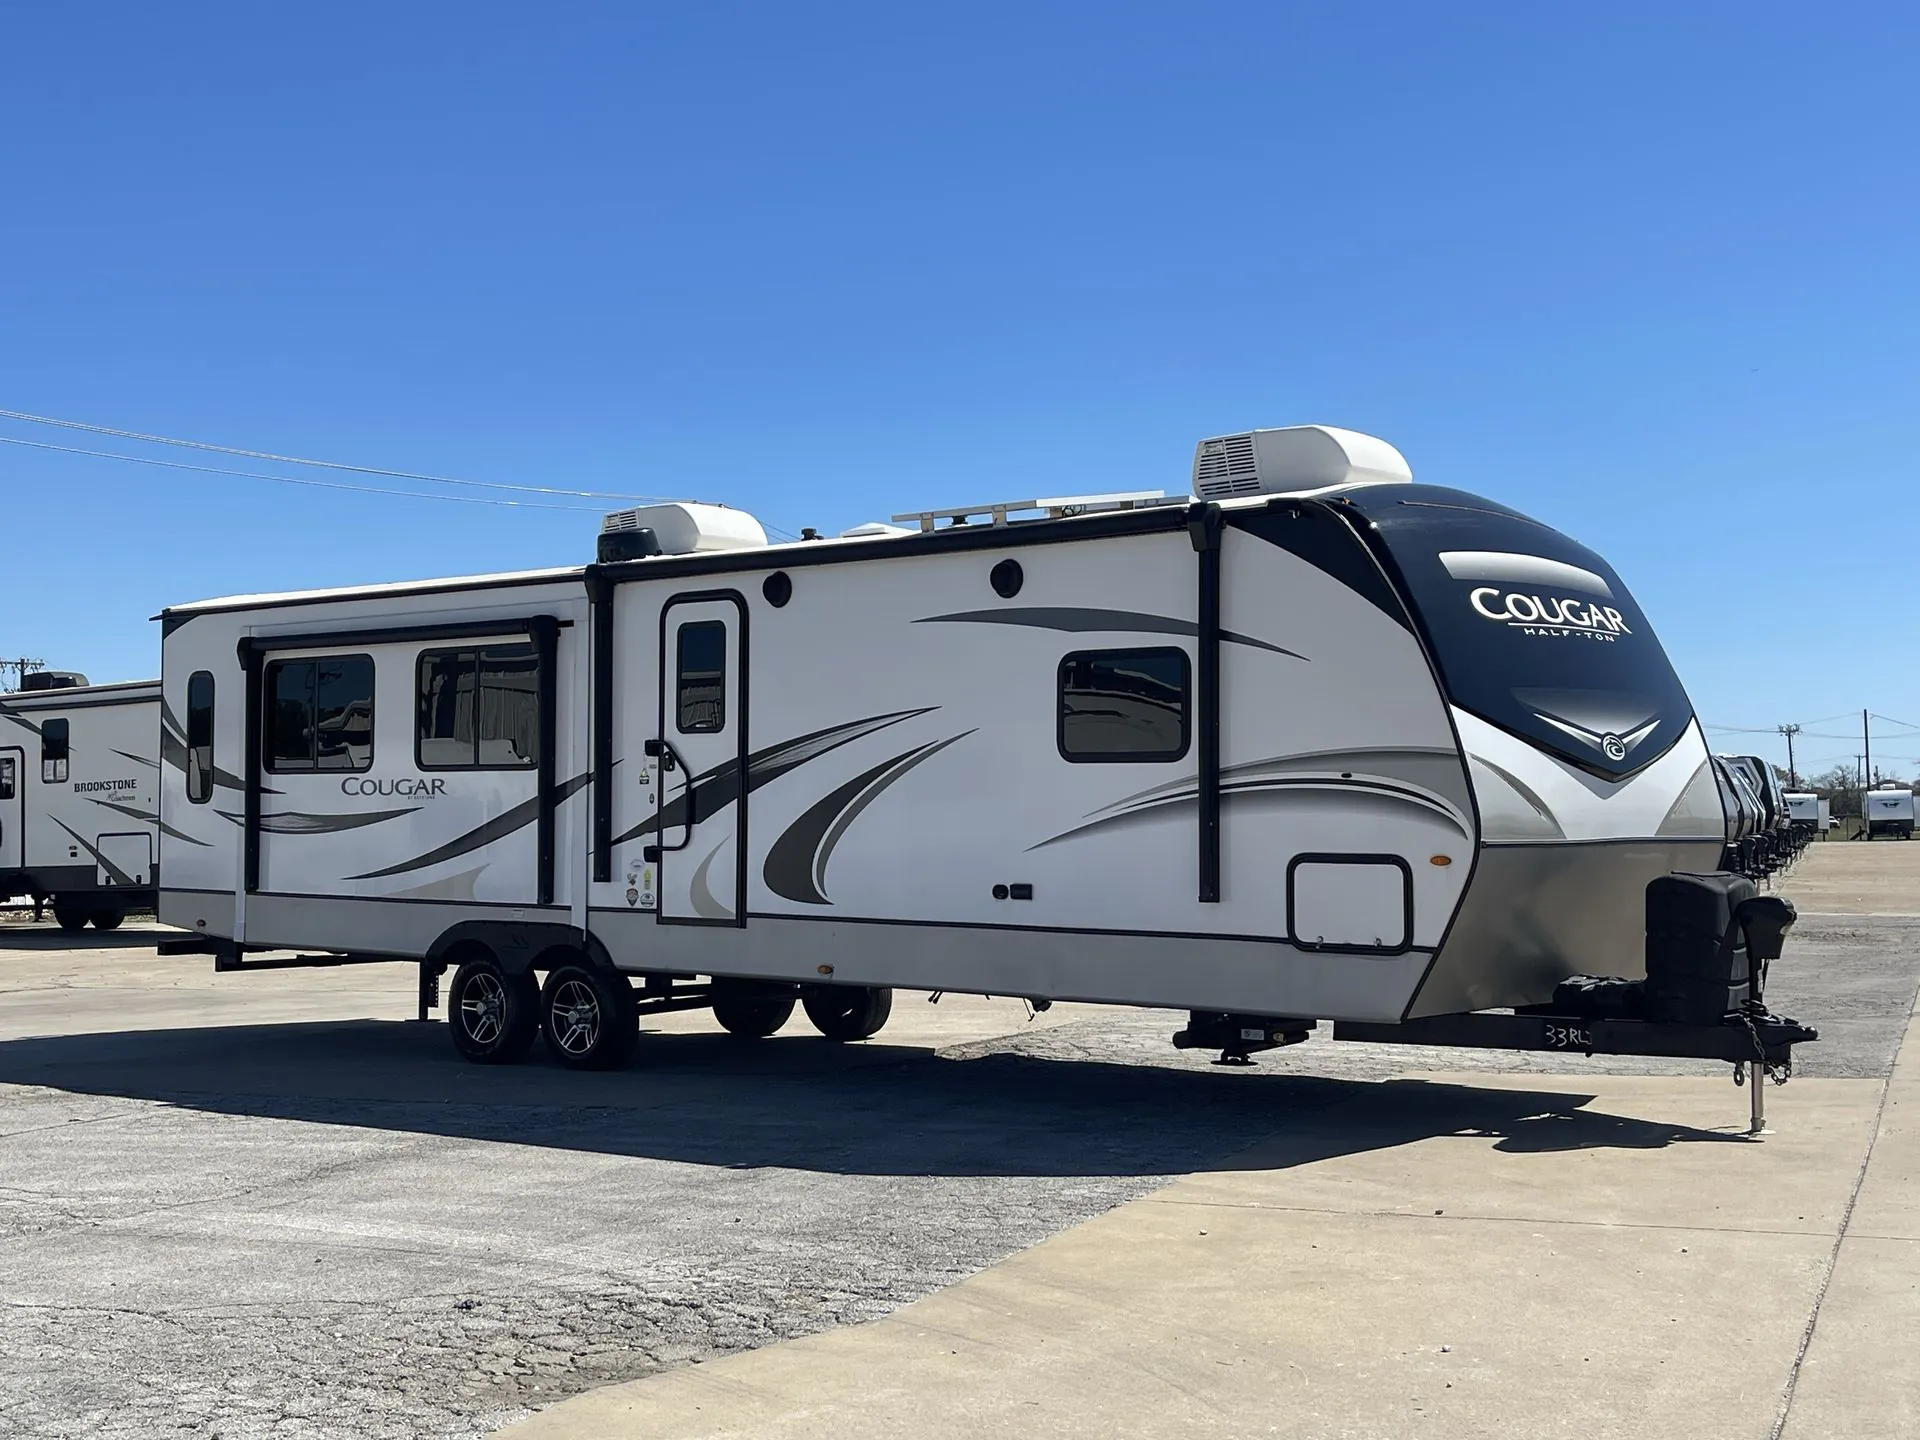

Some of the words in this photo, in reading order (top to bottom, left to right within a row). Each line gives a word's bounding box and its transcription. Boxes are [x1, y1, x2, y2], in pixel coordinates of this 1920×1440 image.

[1470, 587, 1633, 634] COUGAR
[1524, 627, 1615, 642] HALF-TON
[74, 779, 137, 792] BROOKSTONE
[341, 777, 448, 796] COUGAR
